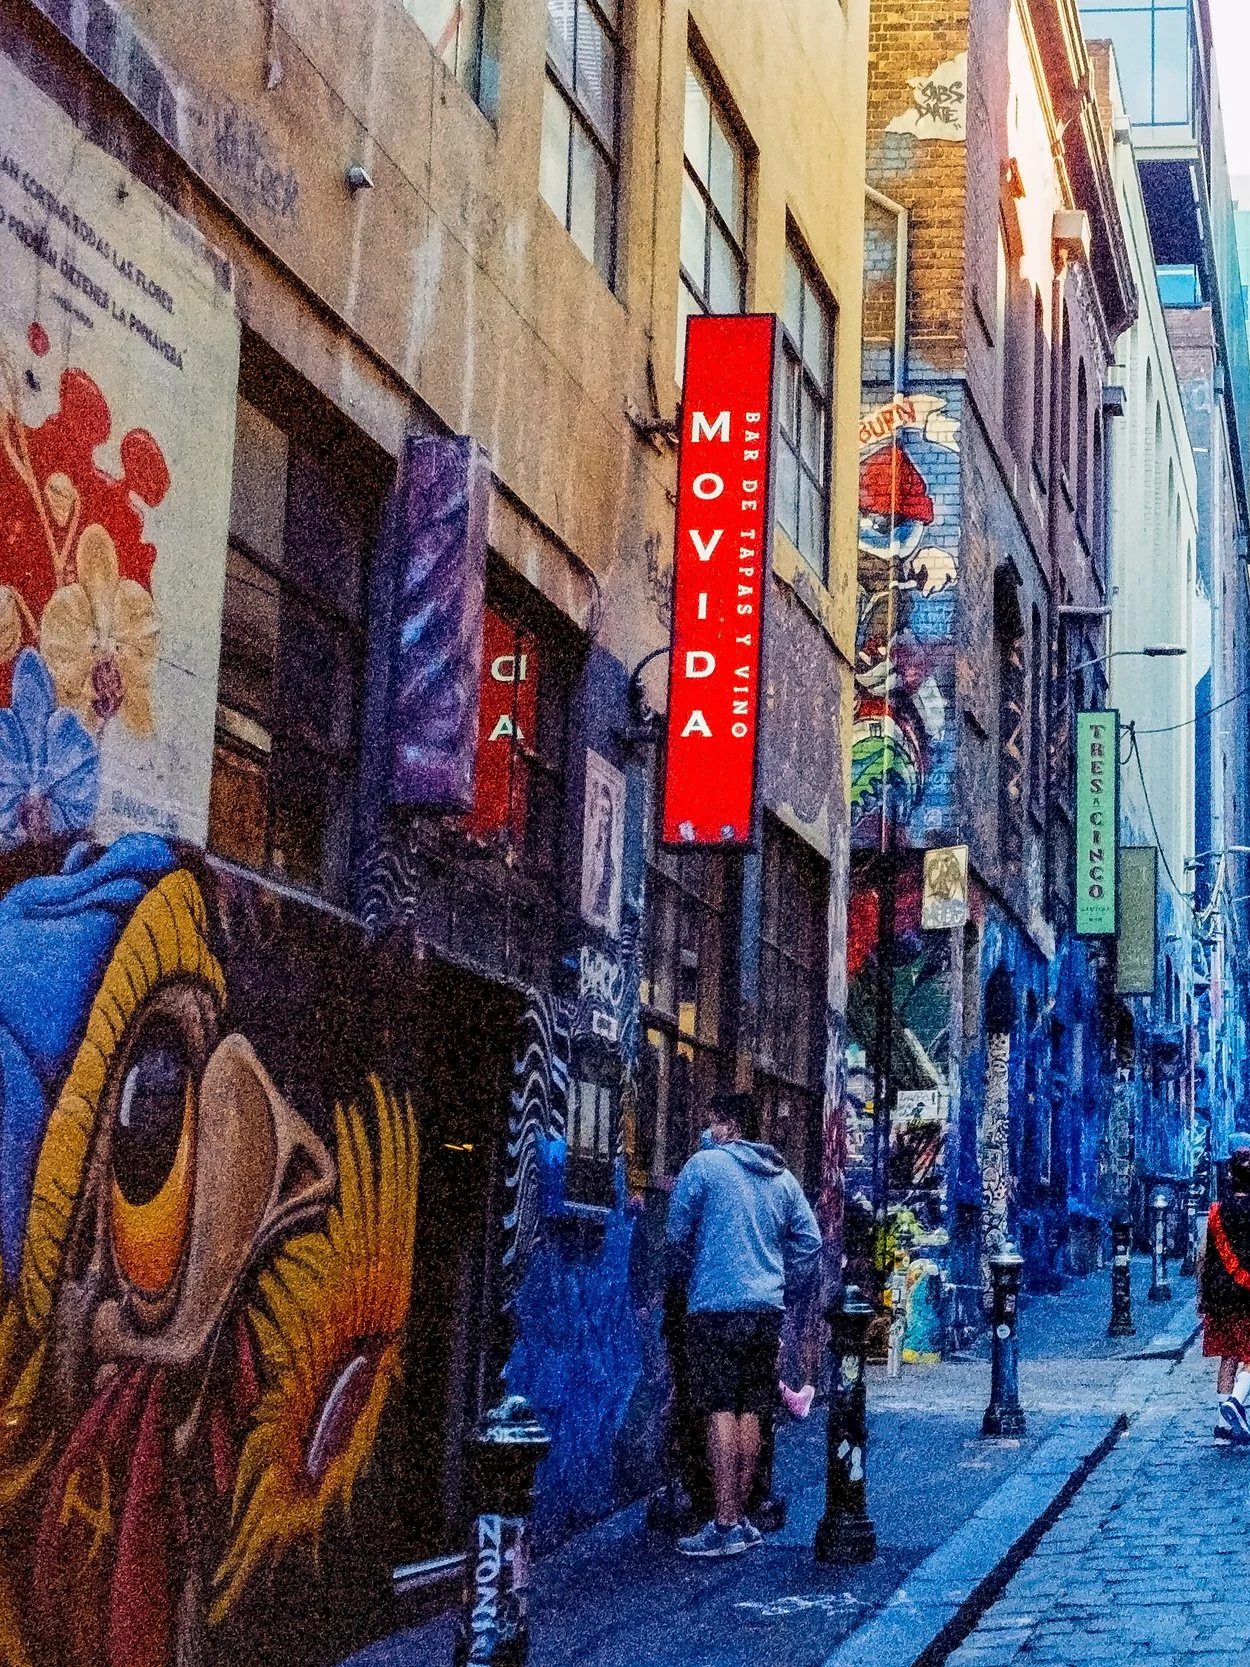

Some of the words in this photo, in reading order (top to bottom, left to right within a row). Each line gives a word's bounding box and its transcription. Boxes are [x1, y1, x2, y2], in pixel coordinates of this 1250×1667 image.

[112, 249, 132, 281] LAS
[111, 300, 126, 326] LA
[743, 411, 761, 461] BAR
[741, 479, 759, 511] DE
[680, 411, 731, 738] MOVIDA
[737, 528, 756, 616] TAPAS
[735, 633, 751, 647] Y
[731, 665, 750, 738] VINO
[1089, 724, 1105, 794] TRES
[1088, 810, 1105, 899] CINCO
